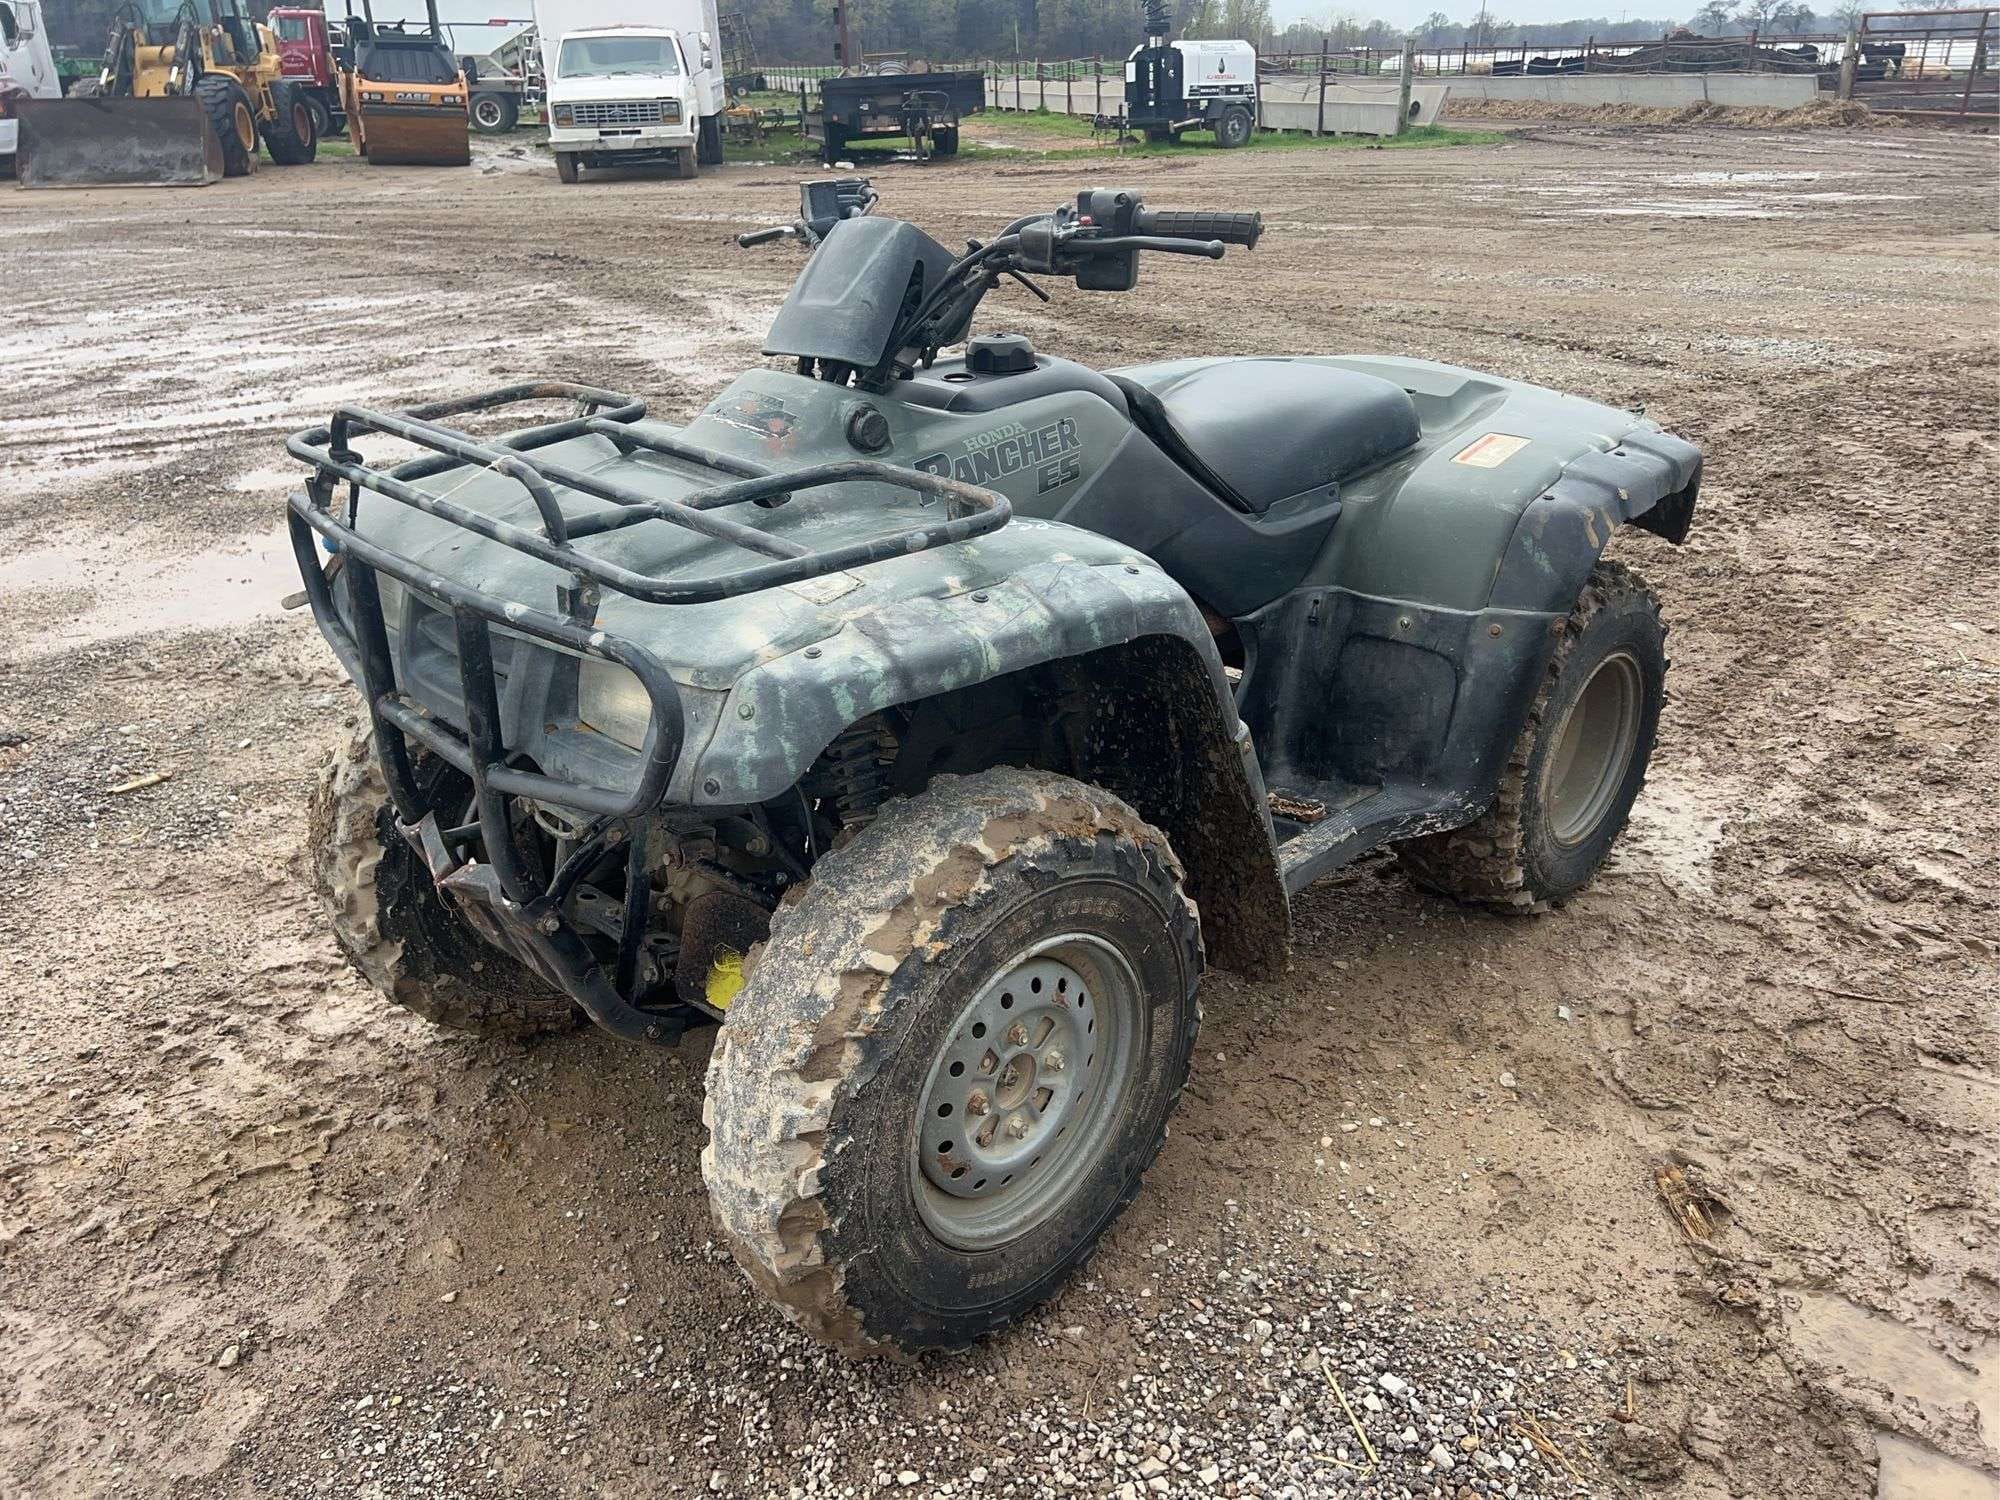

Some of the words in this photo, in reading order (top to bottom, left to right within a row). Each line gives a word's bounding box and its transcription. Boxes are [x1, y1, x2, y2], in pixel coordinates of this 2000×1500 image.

[395, 92, 432, 101] CASE
[962, 422, 1026, 451] HONDA
[912, 417, 1082, 507] RANCHER
[1036, 451, 1081, 496] ES
